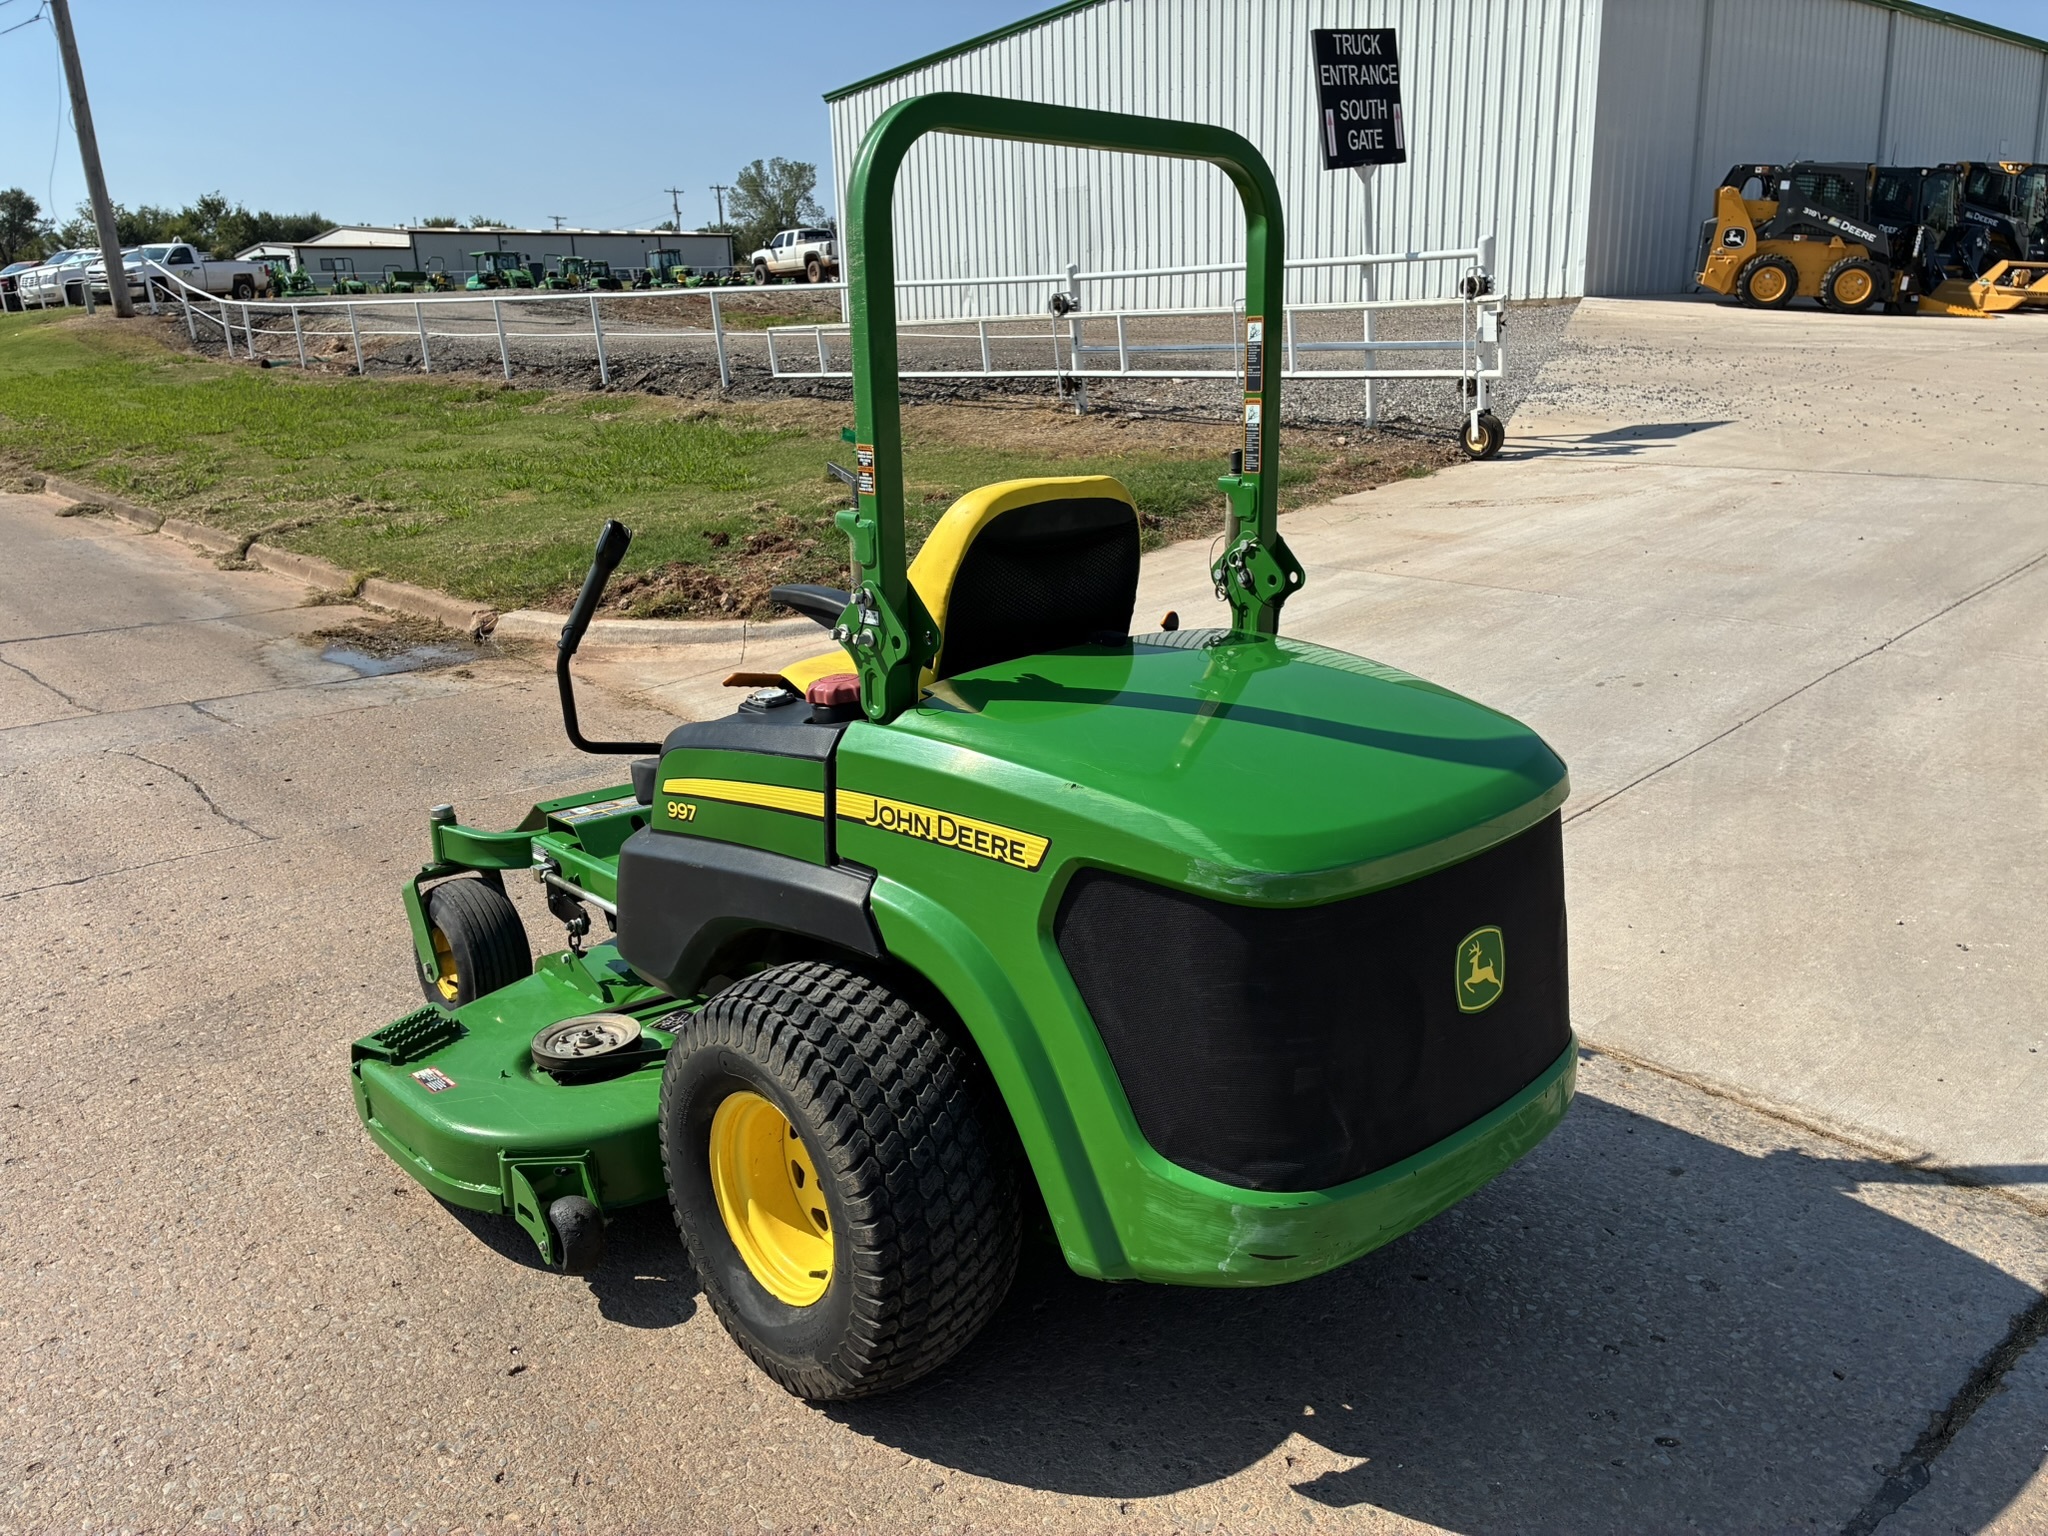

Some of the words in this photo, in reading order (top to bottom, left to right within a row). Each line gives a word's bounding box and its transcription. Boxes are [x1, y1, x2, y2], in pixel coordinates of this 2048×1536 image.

[1333, 34, 1382, 55] TRUCK
[1320, 64, 1398, 86] ENTRANCE
[1340, 99, 1388, 120] SOUTH
[1348, 129, 1384, 150] GATE
[1973, 212, 1999, 227] DEERE
[1840, 220, 1877, 243] DEERE
[667, 800, 697, 822] 997
[865, 799, 932, 839] JOHN
[937, 814, 1027, 866] DEERE
[683, 1209, 740, 1317] KENDA
